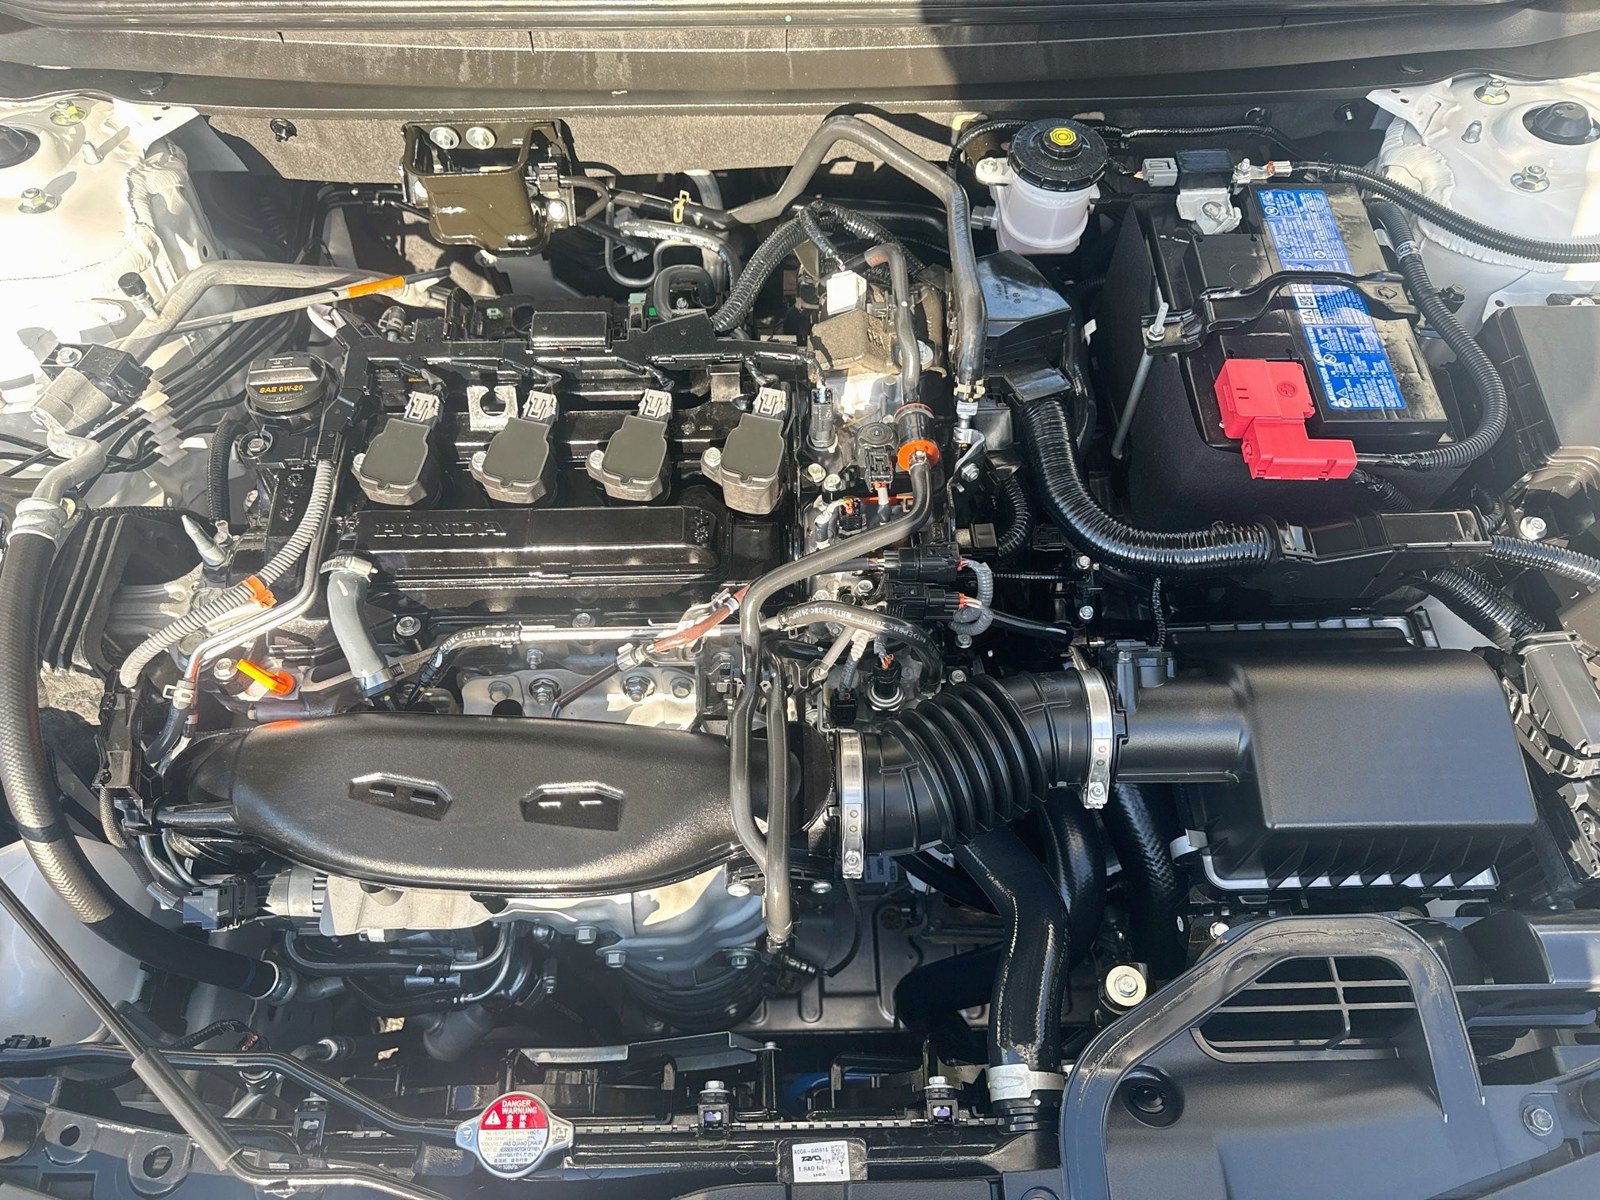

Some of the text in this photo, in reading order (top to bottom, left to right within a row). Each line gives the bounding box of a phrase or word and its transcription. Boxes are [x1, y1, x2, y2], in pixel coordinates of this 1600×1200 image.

[1302, 310, 1314, 322] 4A
[278, 384, 304, 392] 0W-20
[373, 521, 507, 538] HONDA
[501, 1100, 531, 1108] DANGER
[501, 1107, 538, 1115] WARNUNG
